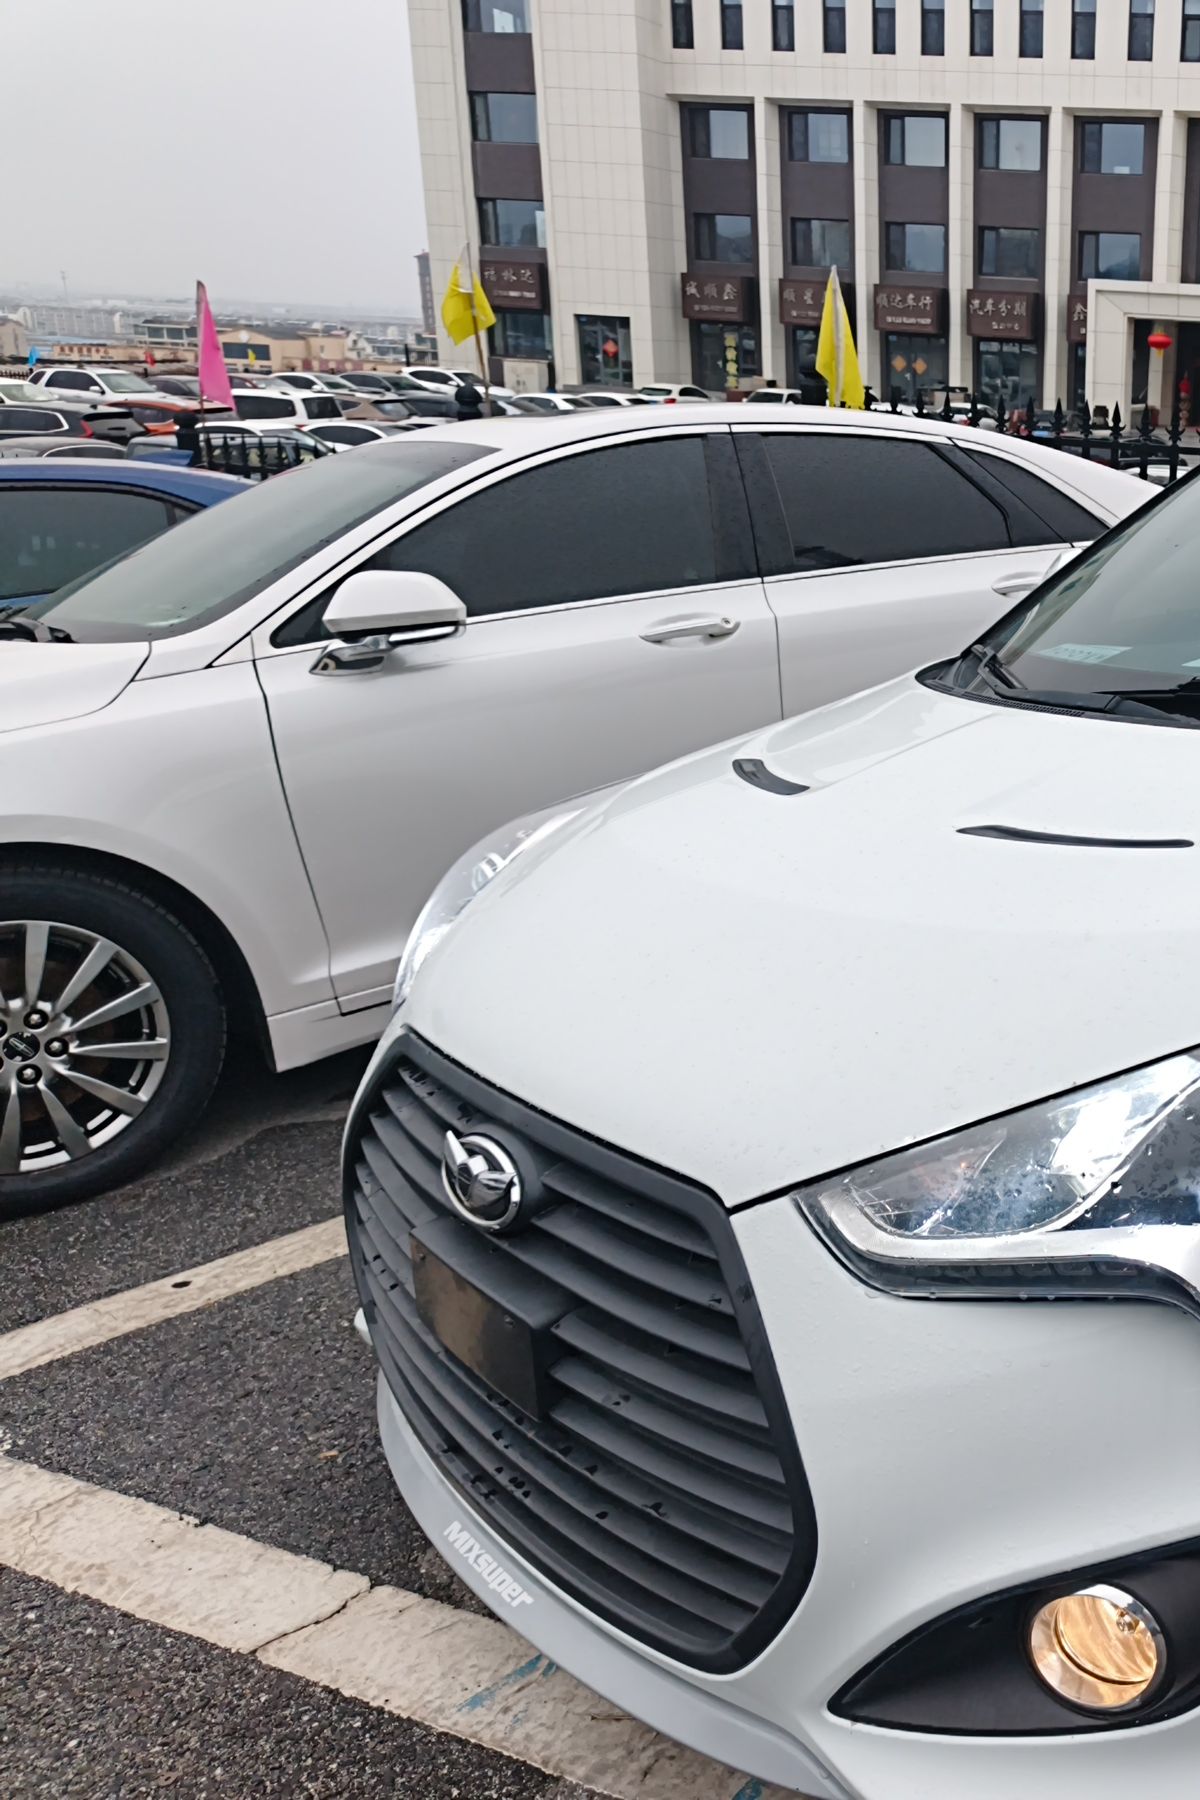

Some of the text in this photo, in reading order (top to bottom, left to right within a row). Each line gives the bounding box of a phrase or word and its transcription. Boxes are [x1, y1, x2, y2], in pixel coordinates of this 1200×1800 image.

[876, 292, 933, 311] 顺达车行
[969, 298, 1026, 317] 汽车分期
[443, 1520, 535, 1607] MIXsuper
